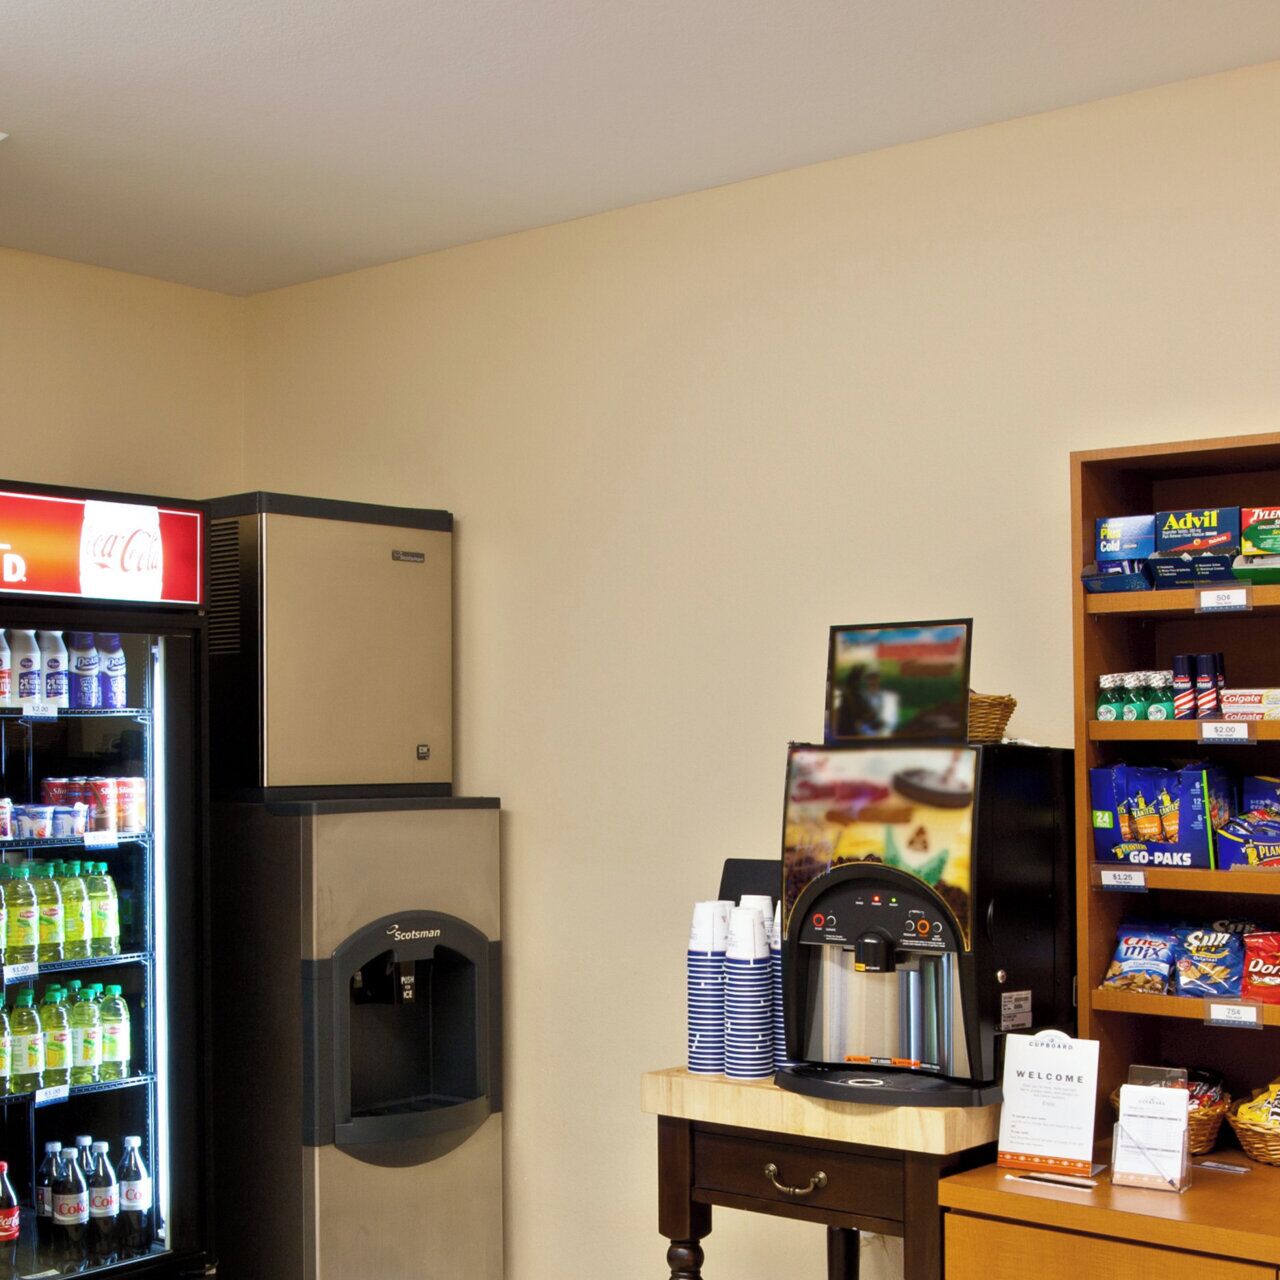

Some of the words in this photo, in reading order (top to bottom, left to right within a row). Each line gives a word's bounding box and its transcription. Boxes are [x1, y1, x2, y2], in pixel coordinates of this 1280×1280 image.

[1163, 509, 1219, 530] Advil
[1100, 540, 1120, 552] Cold
[1217, 594, 1231, 602] 50¢
[1223, 694, 1260, 704] Colgate
[1214, 726, 1235, 734] $2.00
[1096, 811, 1110, 823] 24
[1129, 851, 1192, 866] GO-PAKS
[1112, 873, 1133, 881] $1.25
[394, 929, 441, 941] Scotsman
[1185, 930, 1231, 951] Sun
[1227, 1007, 1240, 1015] 75¢
[1029, 1041, 1073, 1050] CUPBOARD
[1016, 1070, 1084, 1084] WELCOME
